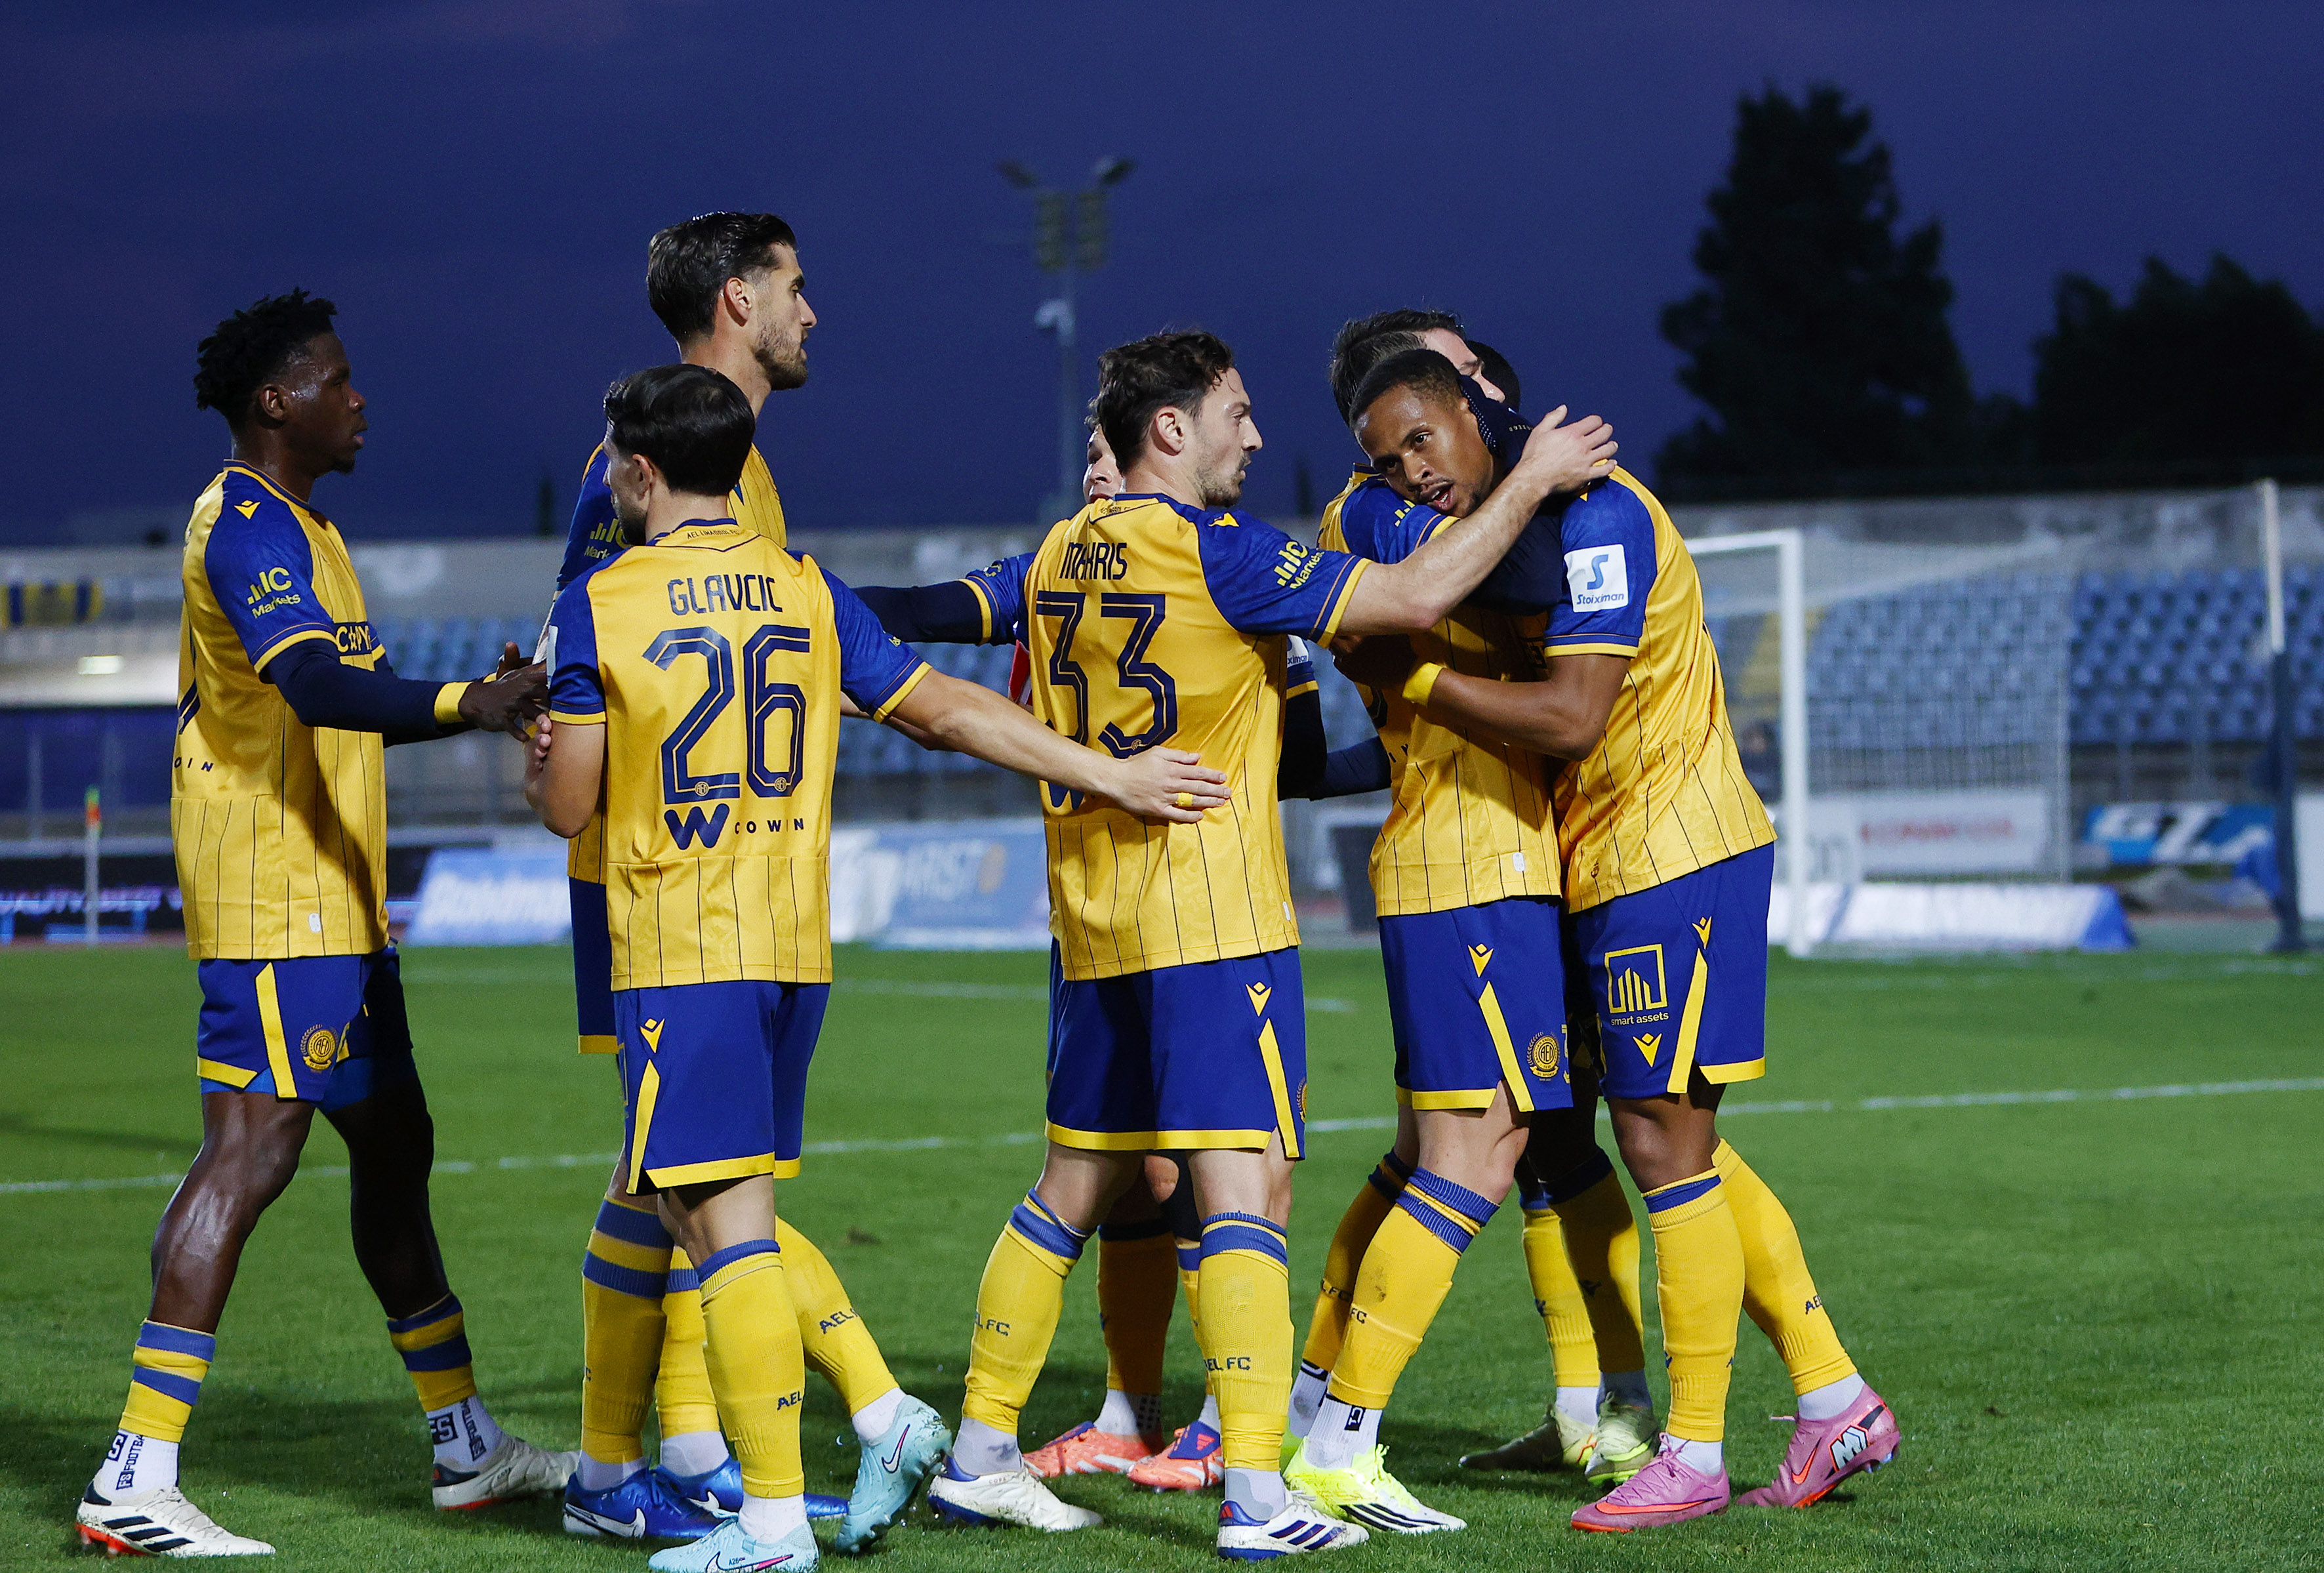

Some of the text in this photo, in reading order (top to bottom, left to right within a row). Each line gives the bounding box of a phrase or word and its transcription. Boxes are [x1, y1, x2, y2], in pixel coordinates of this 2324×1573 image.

[666, 573, 783, 616] GLAVCIC
[1576, 593, 1625, 605] Stoiximan
[251, 594, 301, 619] Markets
[1036, 590, 1178, 760] 33
[642, 624, 810, 805] 26
[1611, 1011, 1669, 1026] smart assets
[819, 1311, 855, 1334] AEL
[987, 1318, 1010, 1337] FC
[1204, 1357, 1251, 1372] EL FC
[777, 1391, 802, 1410] AEL
